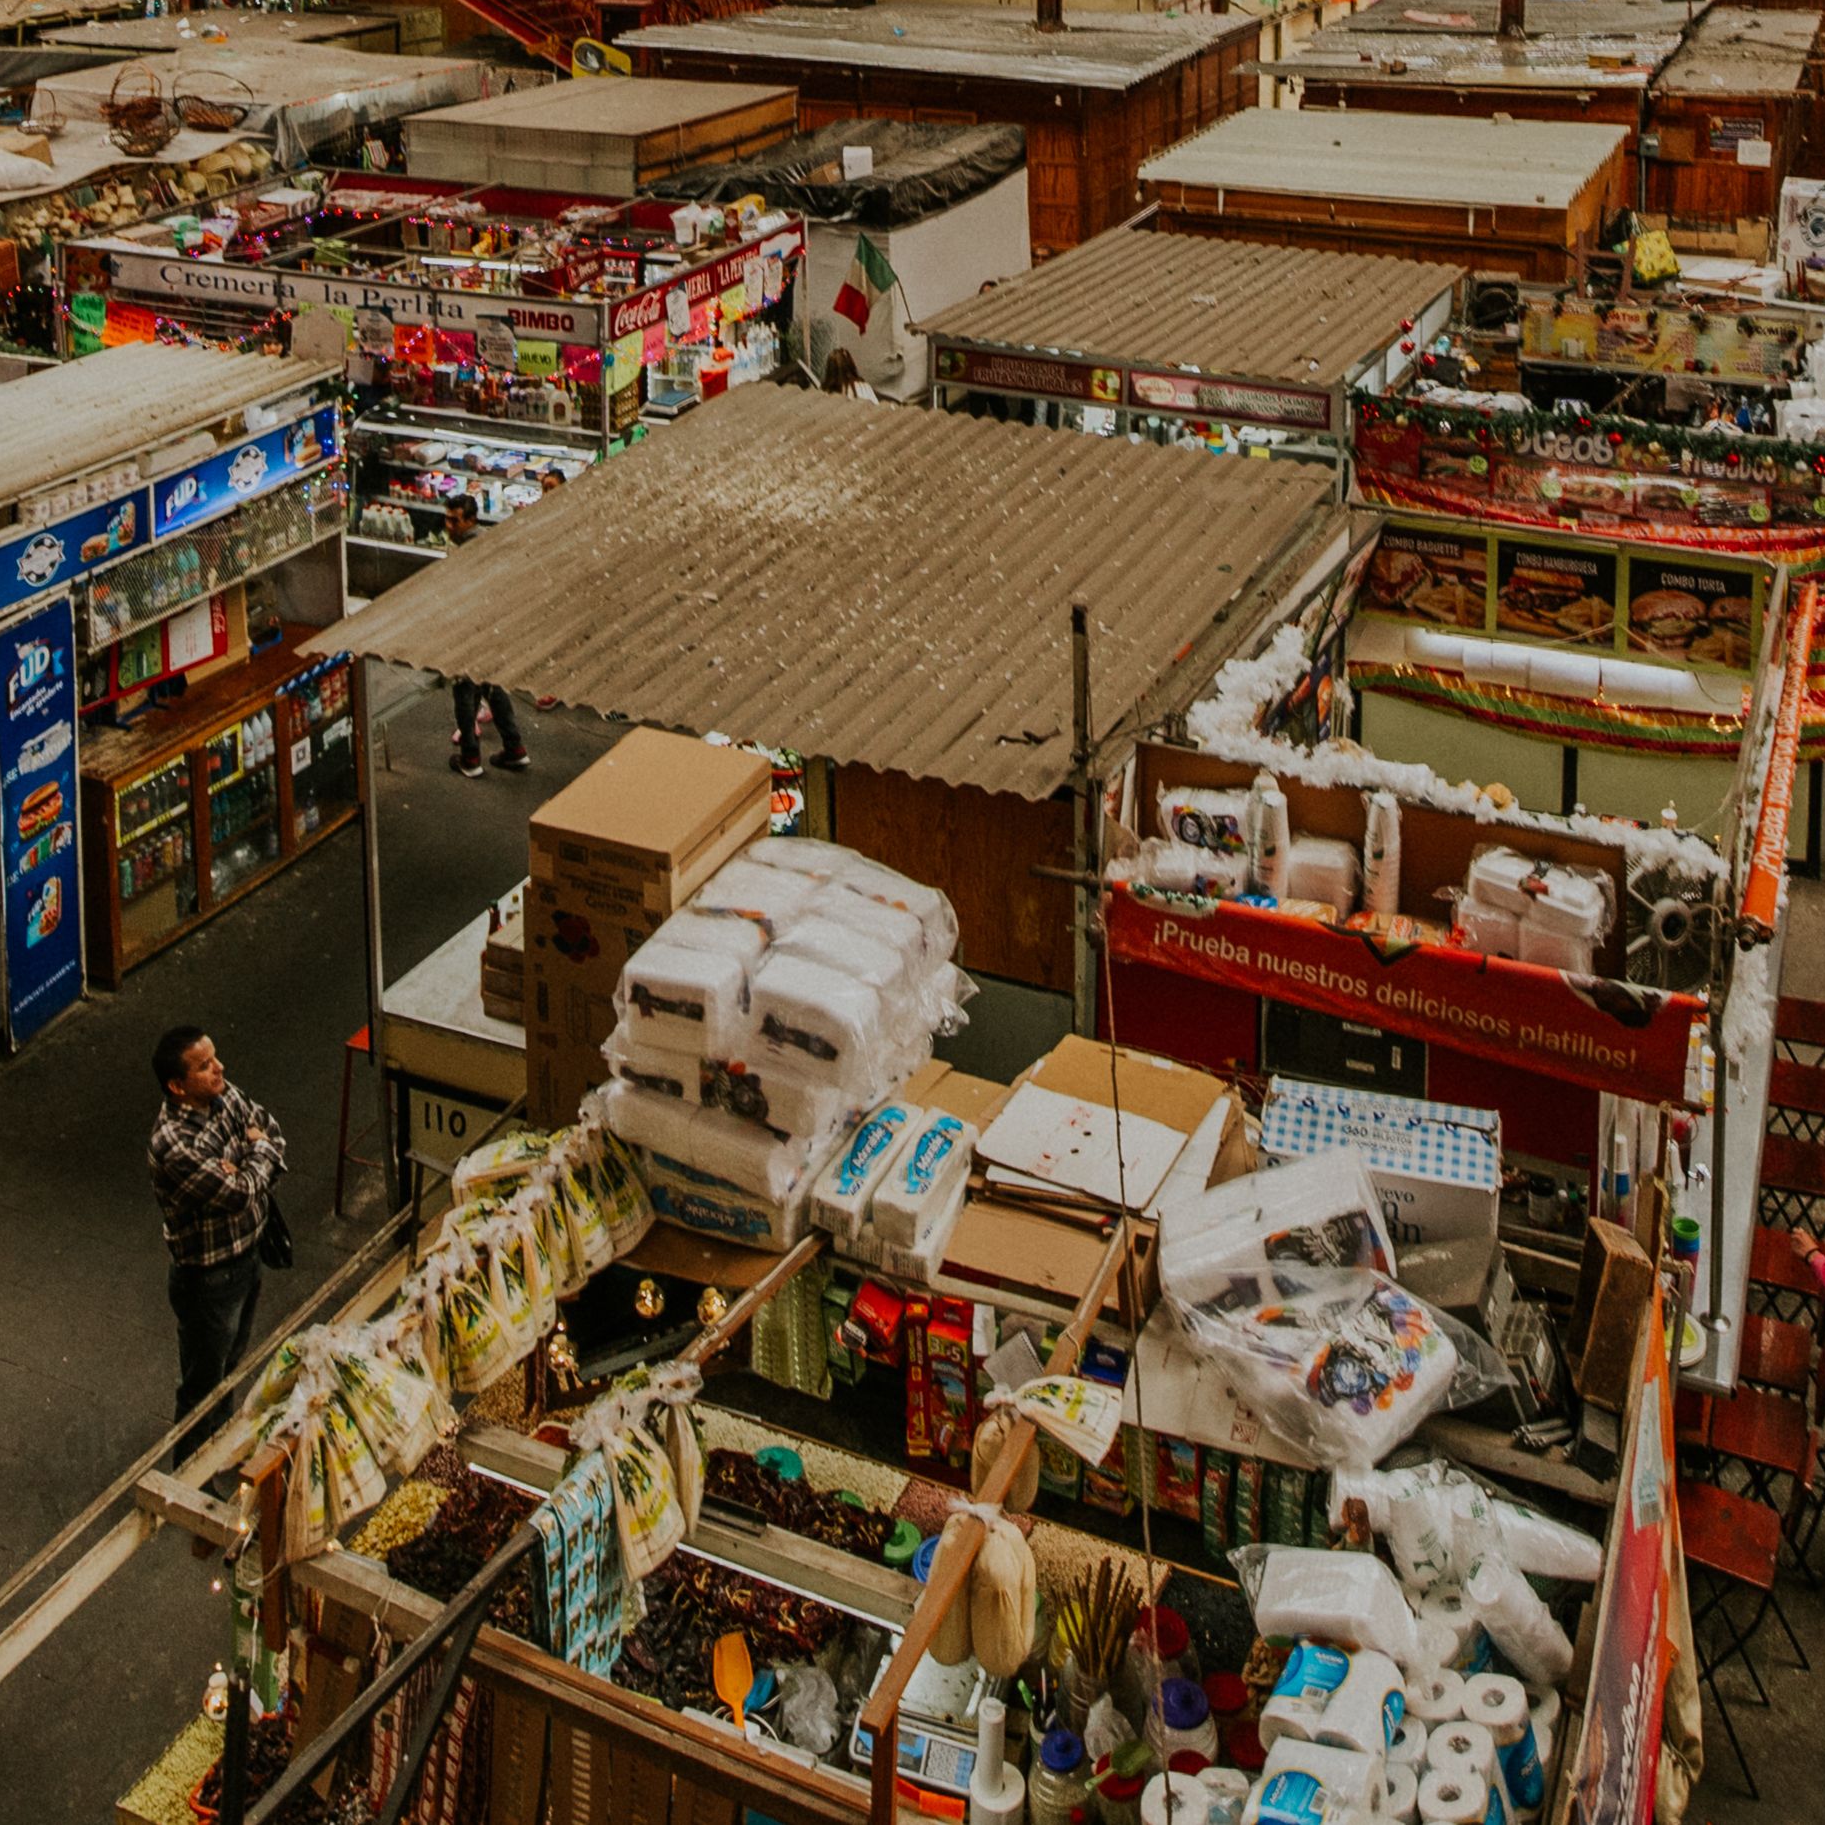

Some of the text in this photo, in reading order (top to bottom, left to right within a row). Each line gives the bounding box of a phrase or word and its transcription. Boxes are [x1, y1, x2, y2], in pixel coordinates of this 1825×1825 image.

[324, 282, 349, 306] la
[361, 287, 464, 320] Perlita
[507, 307, 575, 333] BIMBO
[166, 476, 198, 519] FUD
[1661, 572, 1695, 589] COMBO
[8, 644, 51, 705] FUD
[1153, 917, 1638, 1072] ¡Prueba nuestros deliciosos platillos!
[423, 1100, 467, 1139] 110
